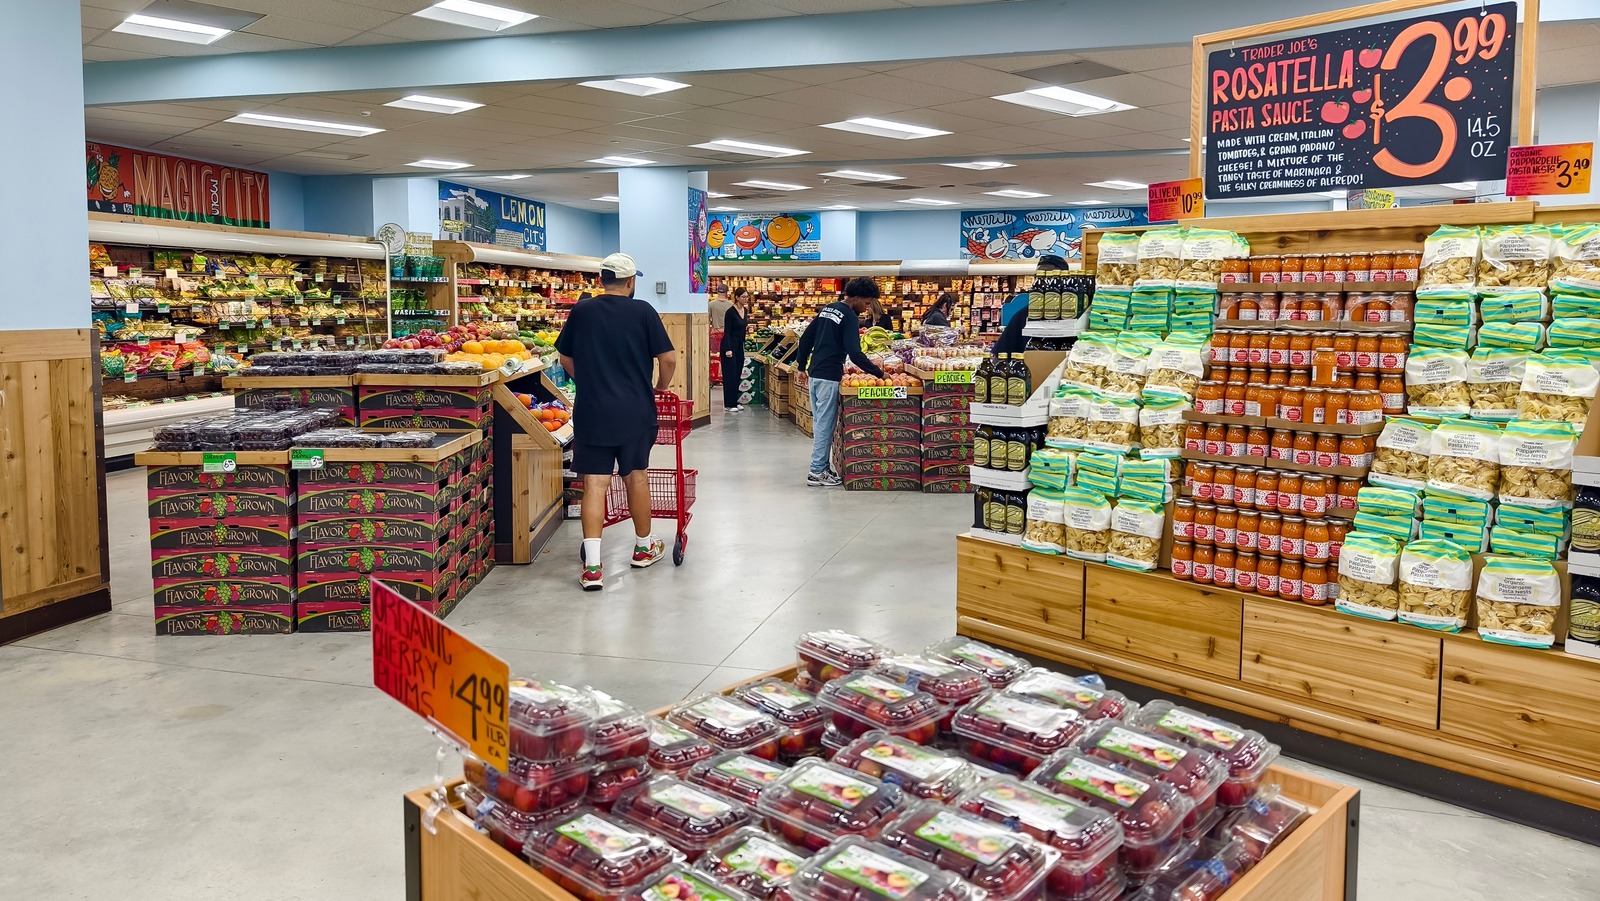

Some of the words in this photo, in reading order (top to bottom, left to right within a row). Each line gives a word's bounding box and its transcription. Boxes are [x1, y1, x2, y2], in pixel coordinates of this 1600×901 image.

[1241, 43, 1284, 62] TRADER
[1287, 38, 1318, 55] JOE'S
[1212, 49, 1354, 105] ROSATELLA
[1212, 106, 1254, 133] PASTA
[1261, 98, 1314, 127] SAUCE
[1467, 116, 1501, 138] 14.5
[1217, 137, 1242, 149] MADE
[1244, 135, 1266, 146] WITH
[1268, 131, 1300, 143] CREAM,
[1301, 129, 1334, 141] ITALIAN
[1269, 144, 1297, 156] GRANA
[1300, 141, 1335, 153] PADANO
[1470, 141, 1497, 158] OZ
[1510, 149, 1543, 158] ORGANIC
[1217, 161, 1253, 173] CHEESE!
[1257, 160, 1263, 169] A
[1267, 156, 1308, 168] MIXTURE
[1311, 154, 1323, 164] OF
[1327, 153, 1345, 162] THE
[1510, 155, 1562, 167] PAPPARDELLE
[1217, 173, 1244, 183] TANGY
[1246, 170, 1271, 181] TASTE
[1272, 169, 1283, 178] OF
[1284, 166, 1331, 177] MARINARA
[1335, 164, 1342, 175] &
[1508, 166, 1531, 175] PASTA
[1532, 164, 1556, 174] NESTS
[133, 153, 215, 225] MAGIC
[220, 167, 267, 229] CITY
[1217, 184, 1231, 193] THE
[1234, 182, 1257, 192] SILKY
[1259, 179, 1305, 190] CREAMINESS
[1306, 178, 1317, 187] OF
[1320, 173, 1364, 187] ALFREDO!
[1149, 187, 1171, 199] OLIVE
[1172, 186, 1181, 197] OIL
[500, 196, 545, 229] LEMON
[964, 213, 1018, 237] merrily
[1024, 211, 1076, 231] merrily
[1082, 208, 1140, 226] merrily
[523, 227, 544, 246] CITY
[936, 374, 966, 383] PEACHES
[311, 392, 344, 404] GROWN
[385, 393, 415, 406] FLAVOR
[419, 393, 453, 405] GROWN
[859, 387, 894, 398] PEACHES
[159, 470, 194, 485] FLAVOR
[237, 471, 275, 484] GROWN
[386, 467, 422, 480] GROWN
[160, 499, 195, 516] FLAVOR
[238, 500, 276, 513] GROWN
[310, 497, 344, 511] FLAVOR
[386, 497, 423, 510] GROWN
[181, 530, 213, 545] FLAVOR
[224, 530, 260, 543] GROWN
[310, 526, 344, 540] FLAVOR
[386, 526, 423, 539] GROWN
[163, 561, 198, 576] FLAVOR
[240, 560, 278, 573] GROWN
[310, 555, 343, 569] FLAVOR
[386, 554, 422, 568] GROWN
[165, 589, 199, 604] FLAVOR
[242, 588, 280, 602] GROWN
[325, 585, 356, 598] FLAVOR
[167, 619, 201, 632] FLAVOR
[244, 618, 280, 630] GROWN
[328, 615, 359, 628] FLAVOR
[374, 587, 452, 666] ORGANIC
[373, 623, 437, 689] CHERRY
[377, 659, 435, 719] PLUMS
